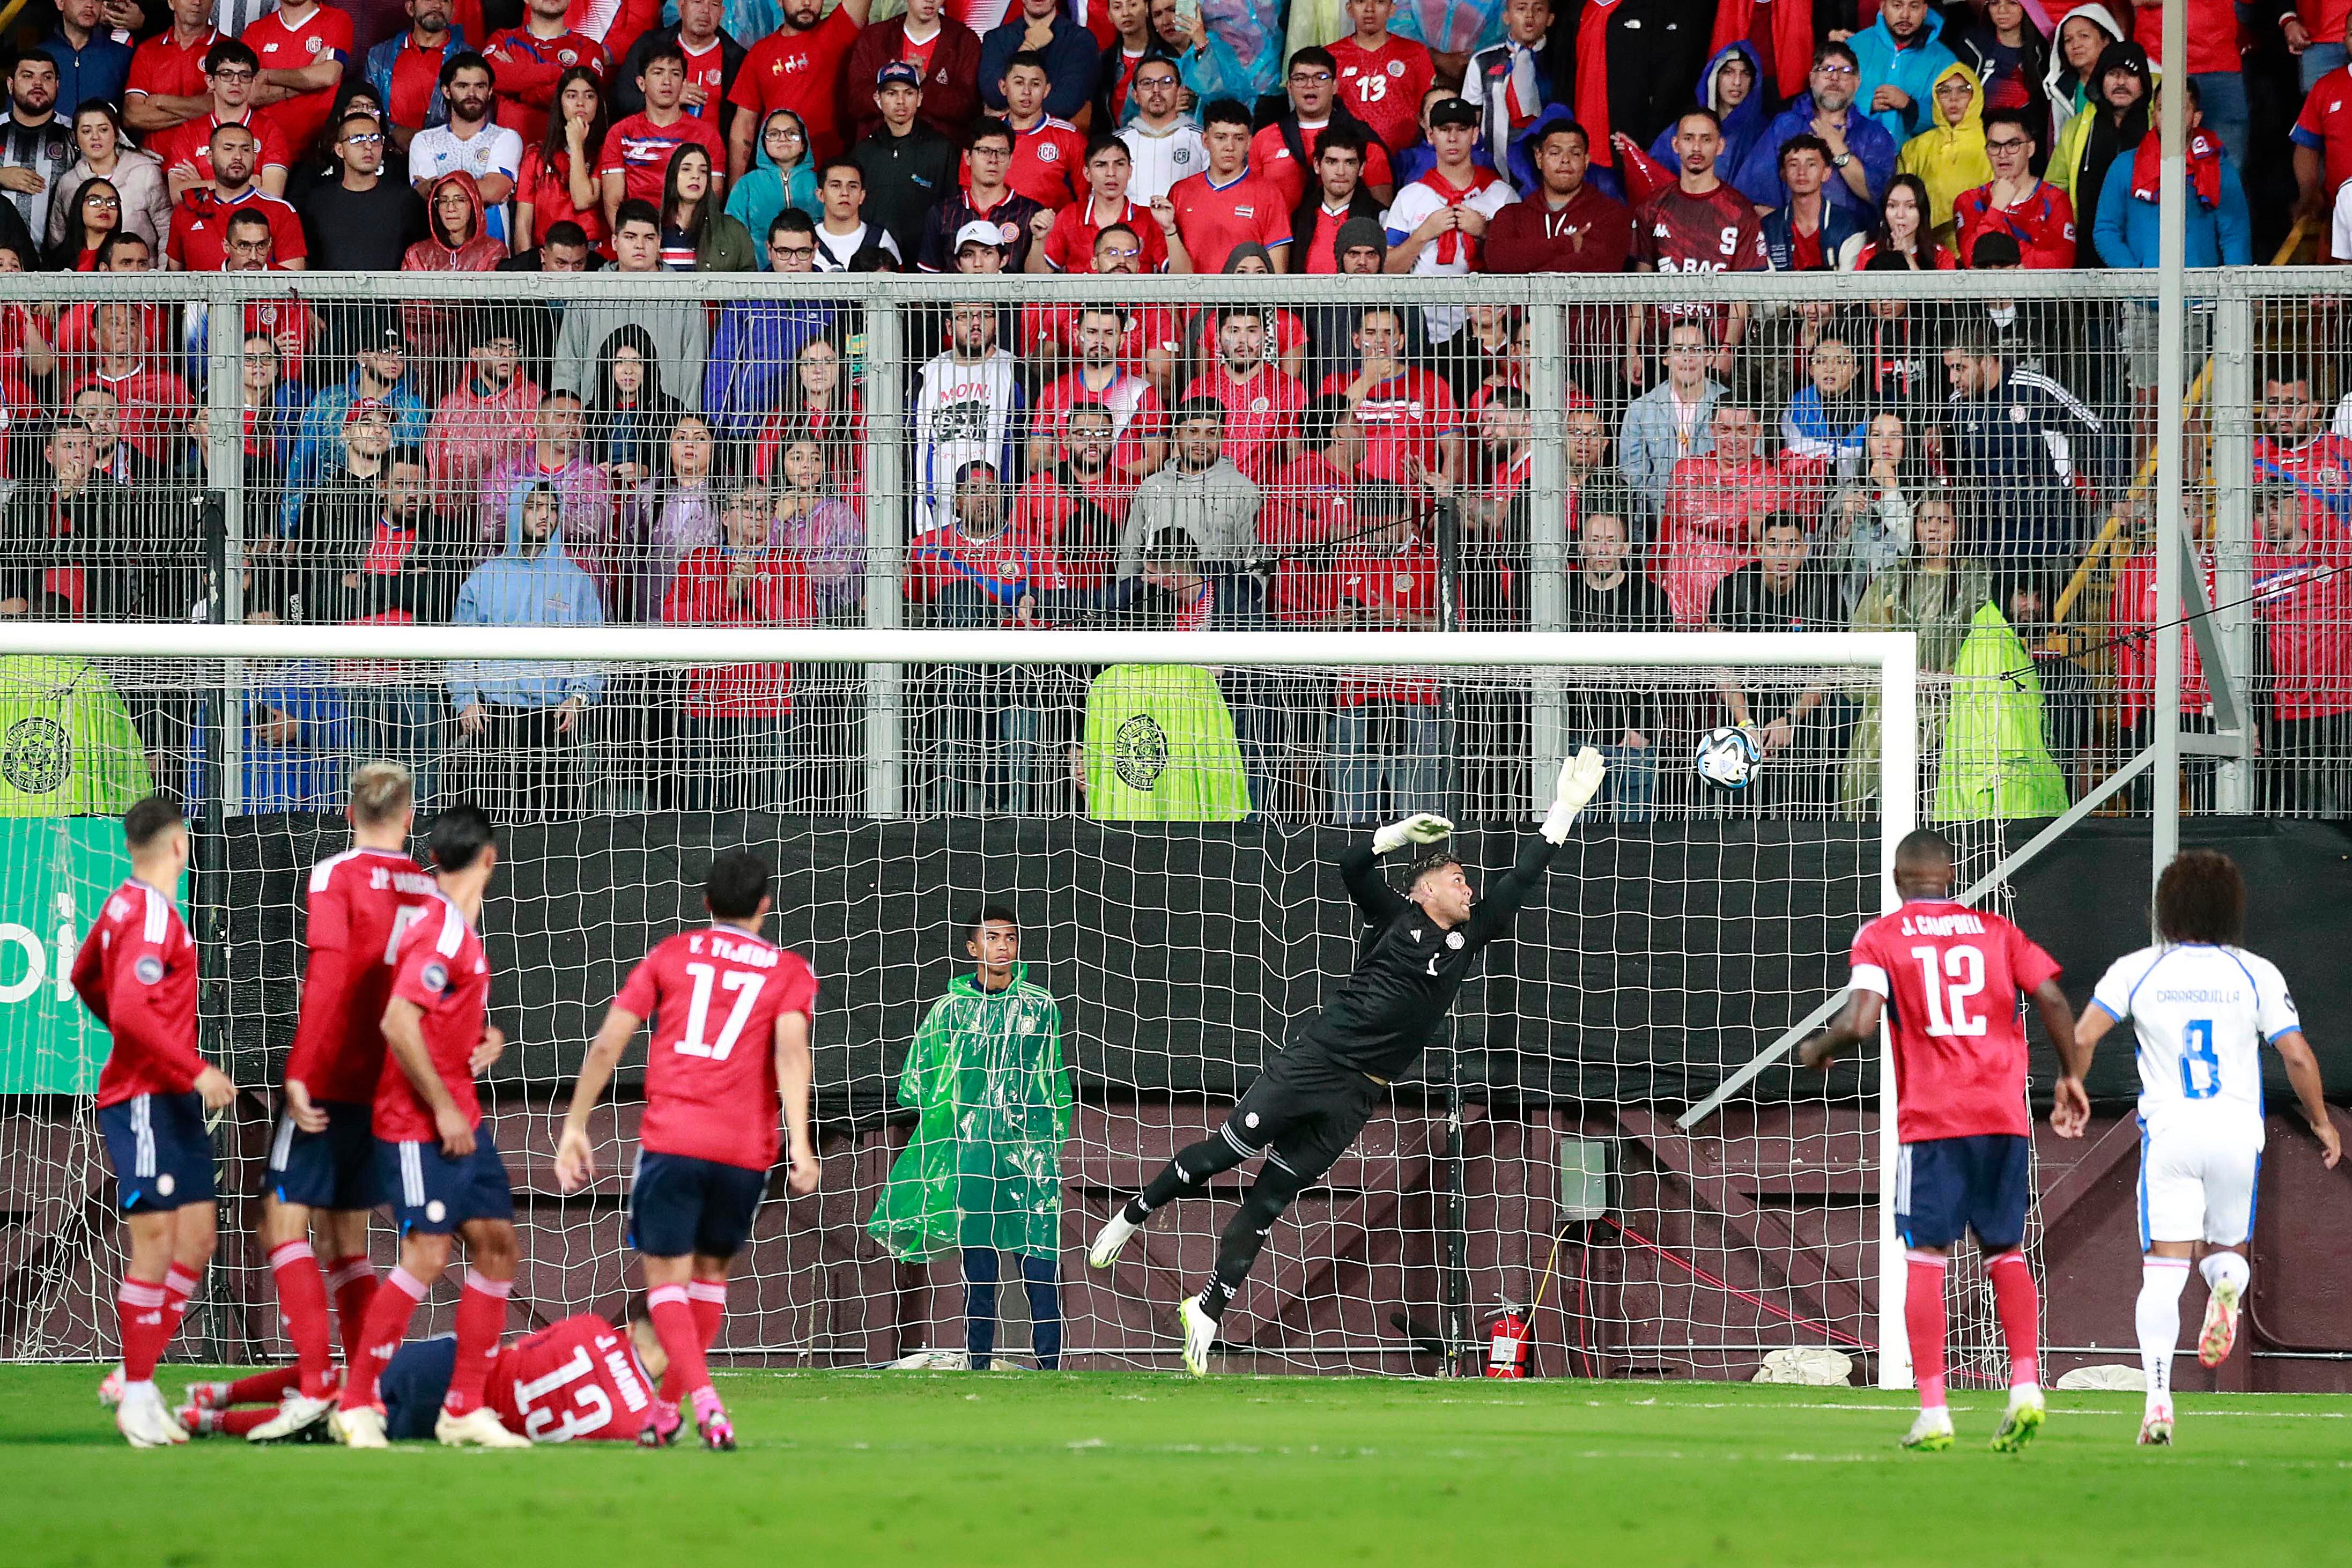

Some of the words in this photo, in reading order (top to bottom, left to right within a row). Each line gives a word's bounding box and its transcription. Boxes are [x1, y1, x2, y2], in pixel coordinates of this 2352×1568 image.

[1356, 74, 1386, 102] 13
[1719, 226, 1739, 255] S
[940, 382, 991, 403] MOIN!
[1915, 914, 1986, 936] CAMPBELL
[1426, 953, 1440, 977] 1
[1911, 945, 1987, 1037] 12
[2157, 989, 2240, 1003] CARRASQUILLA
[674, 962, 767, 1061] 17
[2181, 1019, 2222, 1099] 8
[513, 1344, 613, 1443] 13
